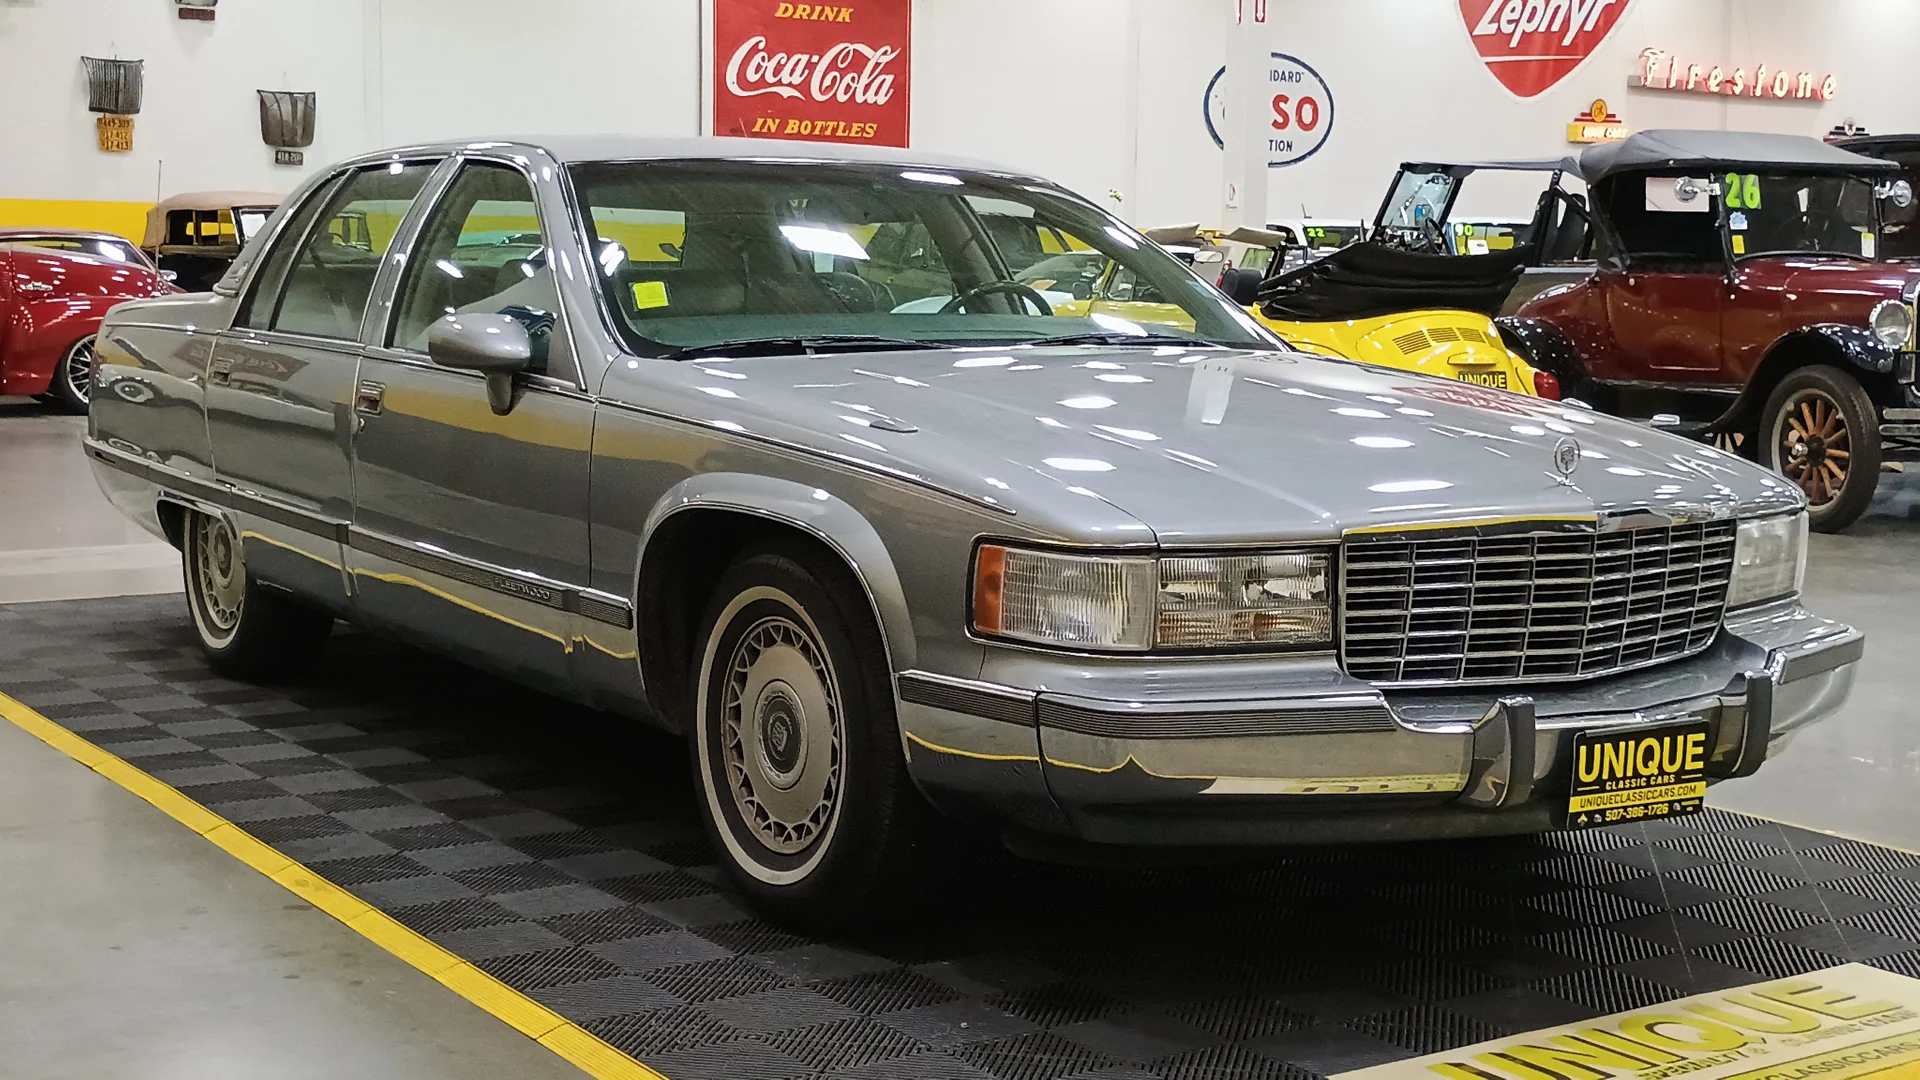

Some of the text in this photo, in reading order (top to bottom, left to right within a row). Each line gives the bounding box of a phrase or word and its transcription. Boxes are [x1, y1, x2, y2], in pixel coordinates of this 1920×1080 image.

[774, 2, 854, 23] DRINK
[726, 35, 902, 105] Coca-Cola
[1639, 47, 1837, 101] Firestone
[752, 117, 877, 138] IN BOTTLES
[1725, 172, 1761, 209] 26
[1307, 228, 1325, 238] 22
[1459, 372, 1506, 388] UNIQUE
[1579, 733, 1705, 783] UNIQUE
[1606, 774, 1675, 791] CLASSIC CARS
[1580, 785, 1697, 808] UNIQUECLASSICCARS.COM
[1605, 803, 1669, 821] 507-386-1726
[1427, 978, 1903, 1080] UNIQUE
